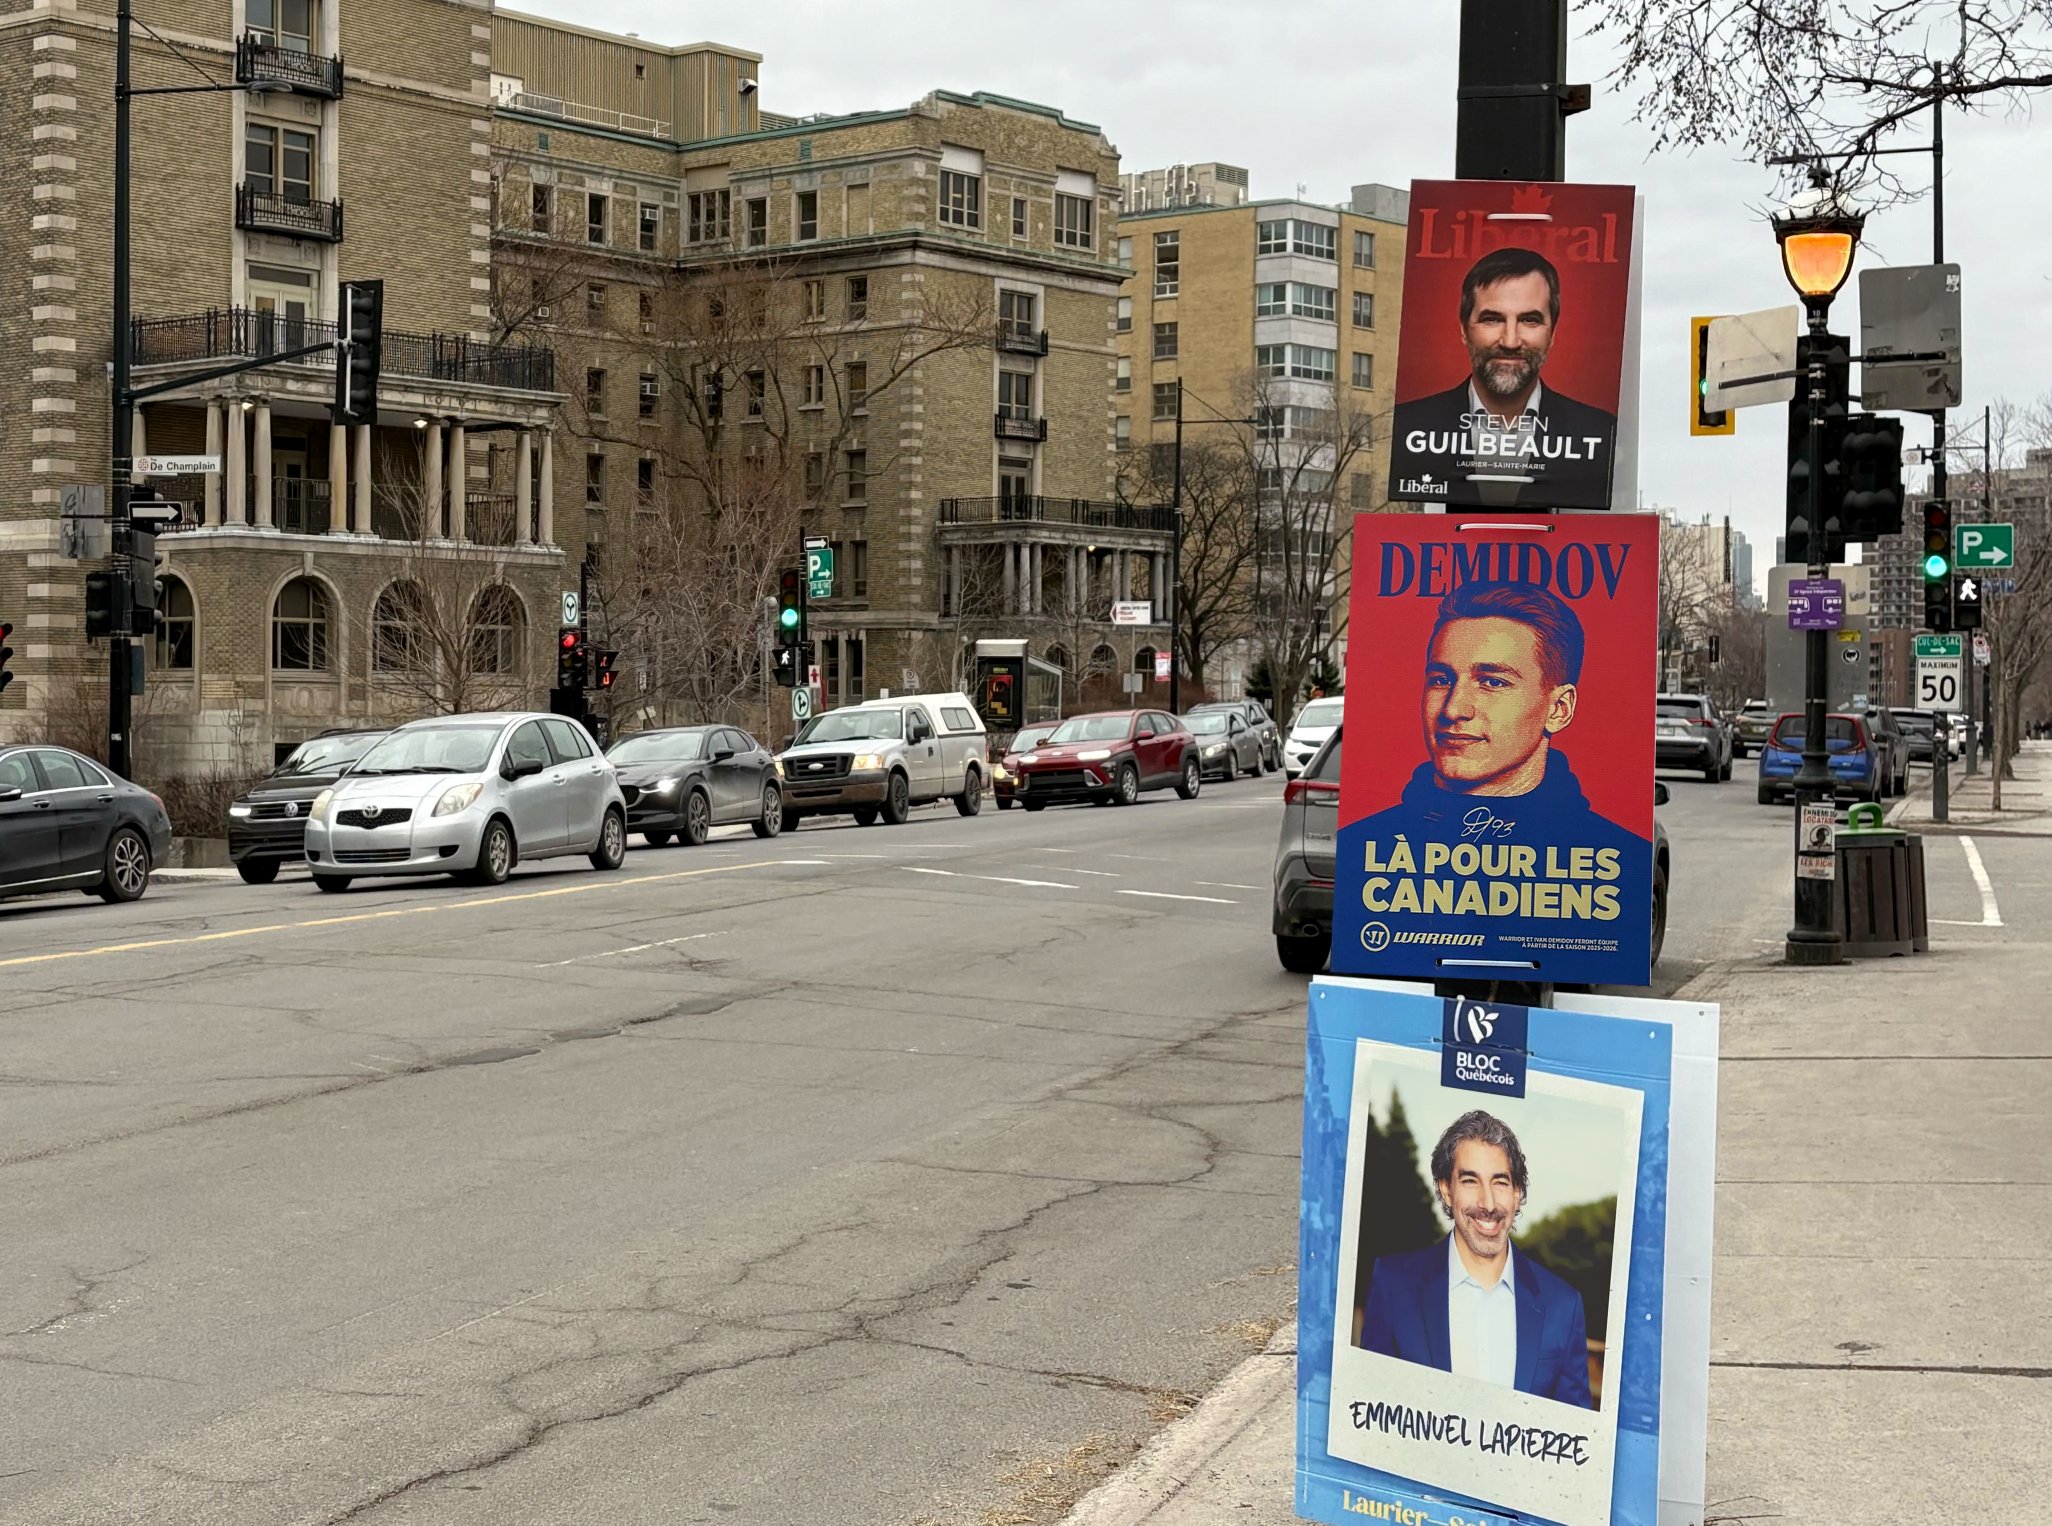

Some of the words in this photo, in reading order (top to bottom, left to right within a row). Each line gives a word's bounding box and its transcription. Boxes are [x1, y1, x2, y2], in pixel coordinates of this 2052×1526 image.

[1459, 413, 1548, 432] STEVEN
[1405, 430, 1602, 460] GUILBEAULT
[150, 462, 163, 471] De
[166, 461, 216, 473] Champlain
[1963, 531, 1983, 555] P
[810, 555, 821, 579] P
[1377, 542, 1632, 600] DEMIDOV
[1917, 636, 1960, 647] CUL-DE-SAC
[1920, 661, 1958, 669] MAXIMUM
[1922, 675, 1957, 702] 50
[1364, 833, 1417, 873] LÀ
[1424, 842, 1537, 878] POUR
[1546, 846, 1622, 881] LES
[1362, 876, 1622, 921] CANADIENS
[1392, 931, 1486, 947] WARRIOR
[1456, 1051, 1501, 1072] BLOC
[1456, 1067, 1515, 1085] Québécois
[1349, 1401, 1472, 1447] EMMANUEL
